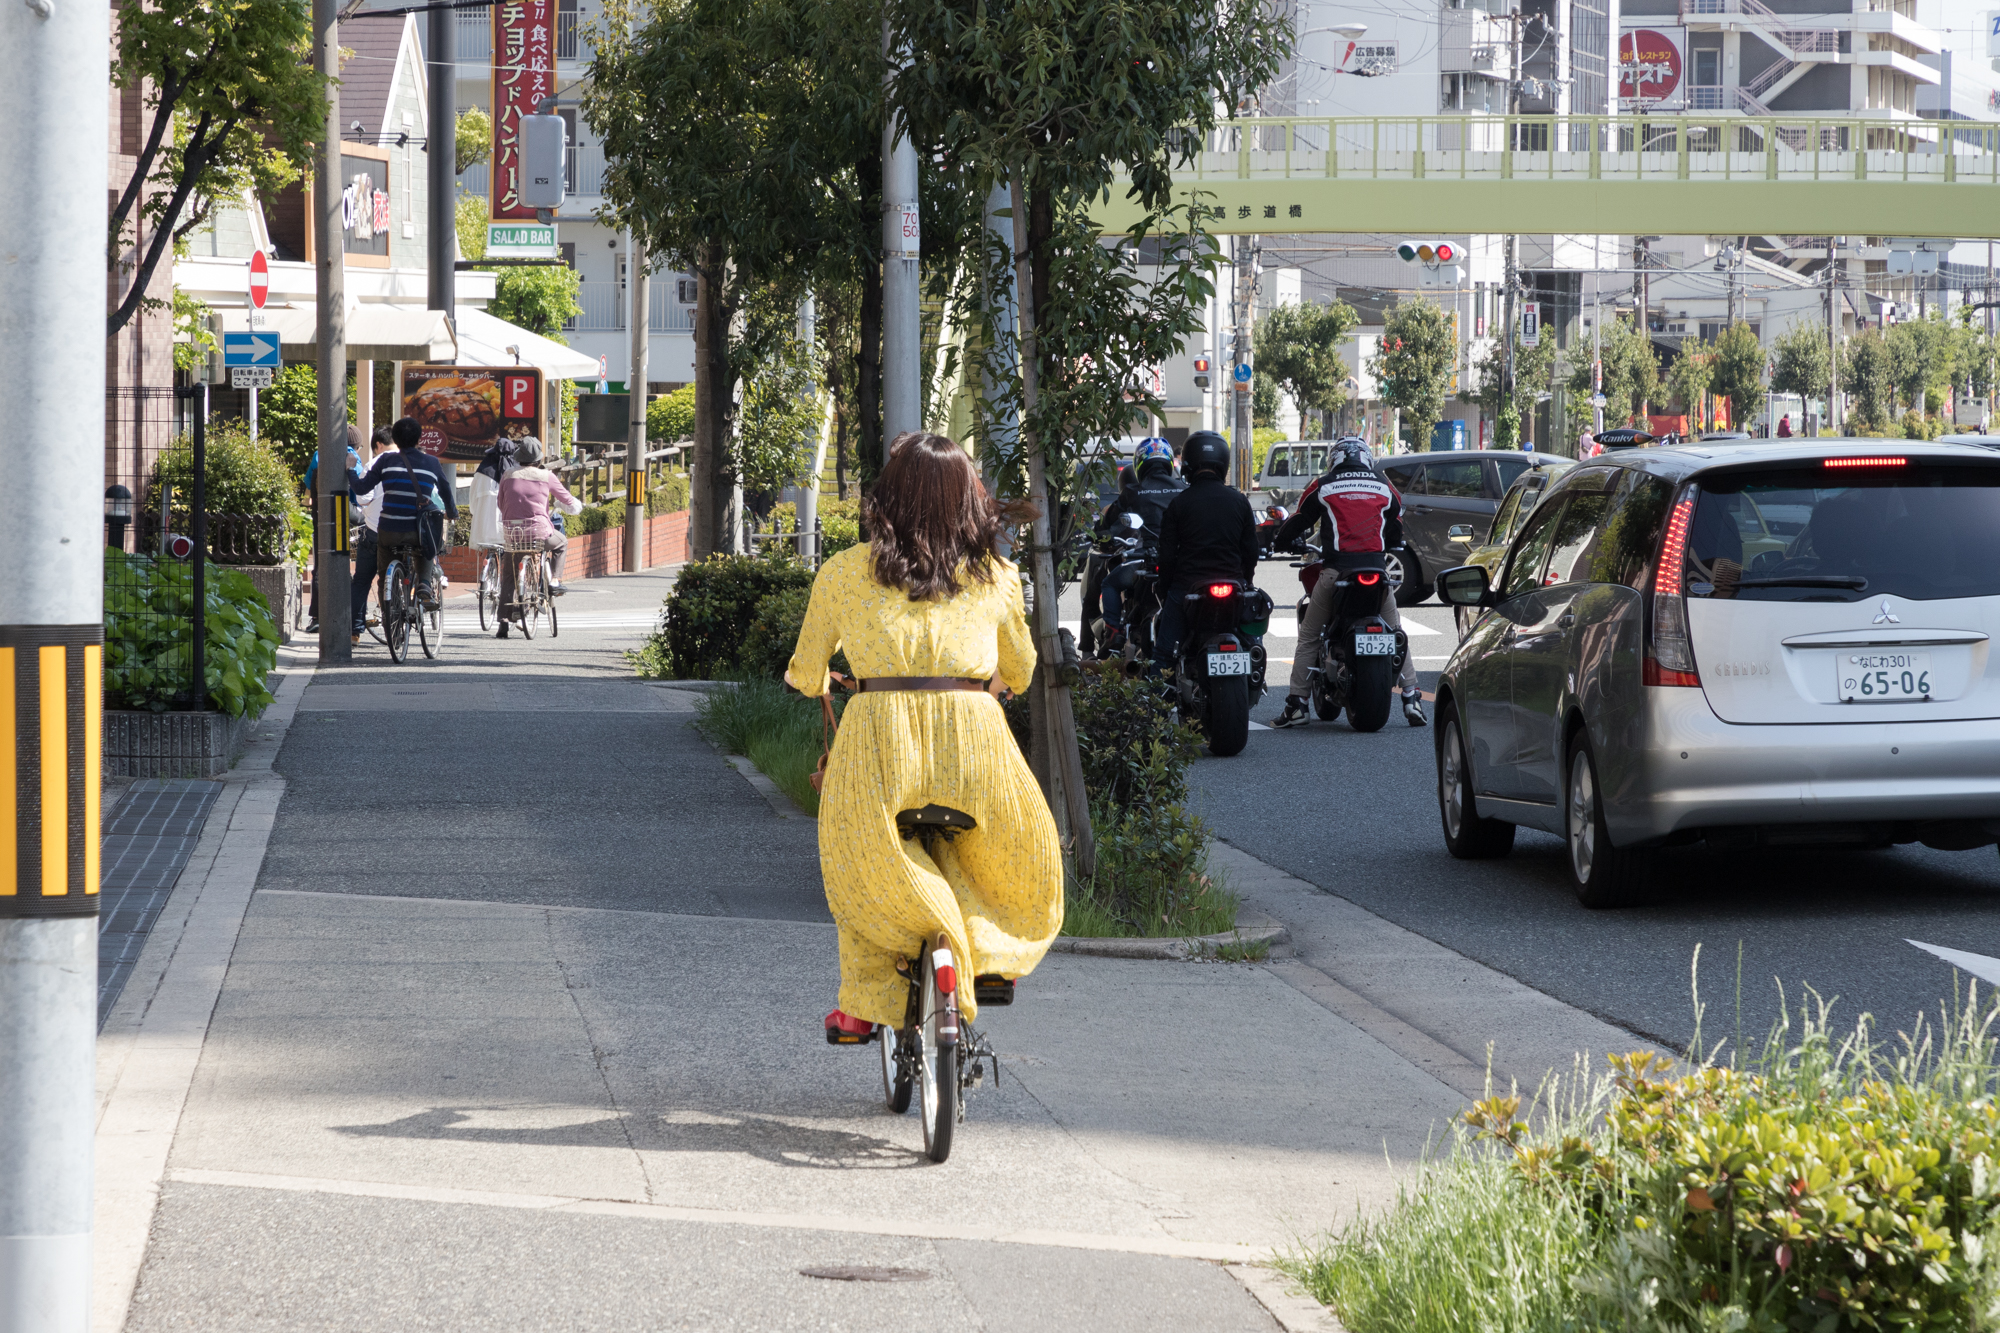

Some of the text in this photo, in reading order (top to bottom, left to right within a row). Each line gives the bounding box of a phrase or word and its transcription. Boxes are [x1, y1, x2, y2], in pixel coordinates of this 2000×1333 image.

[530, 0, 548, 114] !!食べ応えの
[500, 2, 526, 212] チョップドハンバーグ
[493, 230, 552, 245] SALAD BAR
[233, 377, 270, 387] ここまで
[512, 379, 528, 400] P
[418, 438, 443, 446] ンバーグ
[1600, 434, 1634, 443] Kanky
[1336, 471, 1377, 480] HONDA
[1332, 482, 1381, 491] Honda Racing
[1357, 642, 1394, 654] 50-26
[1210, 661, 1247, 674] 50-21
[1858, 654, 1912, 669] なにわ301
[1714, 661, 1771, 677] GRANDIS
[1844, 670, 1931, 696] の 65-06
